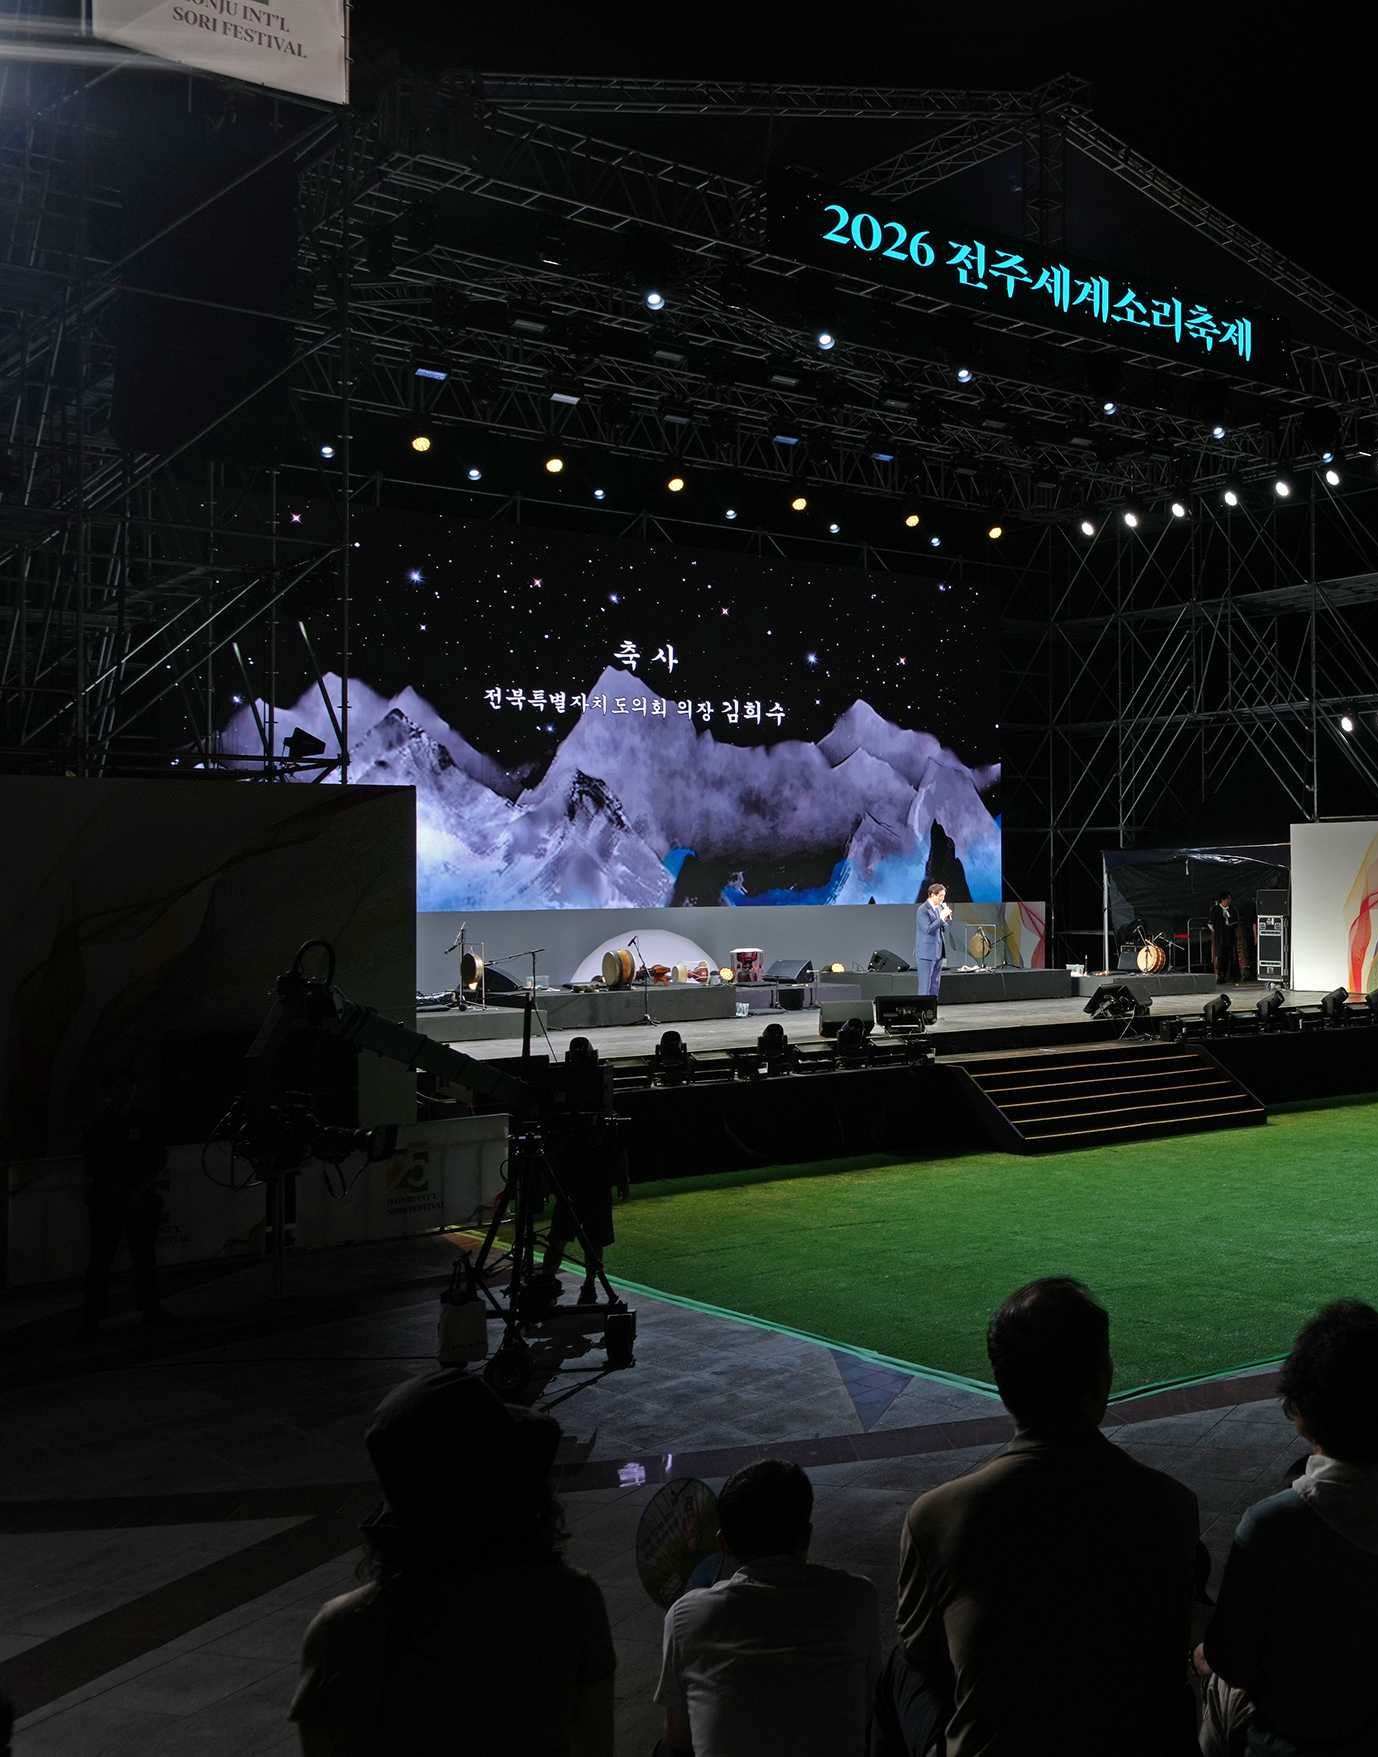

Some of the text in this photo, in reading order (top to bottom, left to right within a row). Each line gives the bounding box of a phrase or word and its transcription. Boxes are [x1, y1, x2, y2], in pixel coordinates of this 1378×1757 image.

[172, 6, 307, 59] SORI FESTIVAL
[242, 5, 290, 33] INT'L
[822, 204, 1252, 361] 2026 전주세계소리축제
[483, 686, 787, 727] 전북특별자치도의회 의장 김희수
[387, 1201, 445, 1215] SORI FESTIVAL
